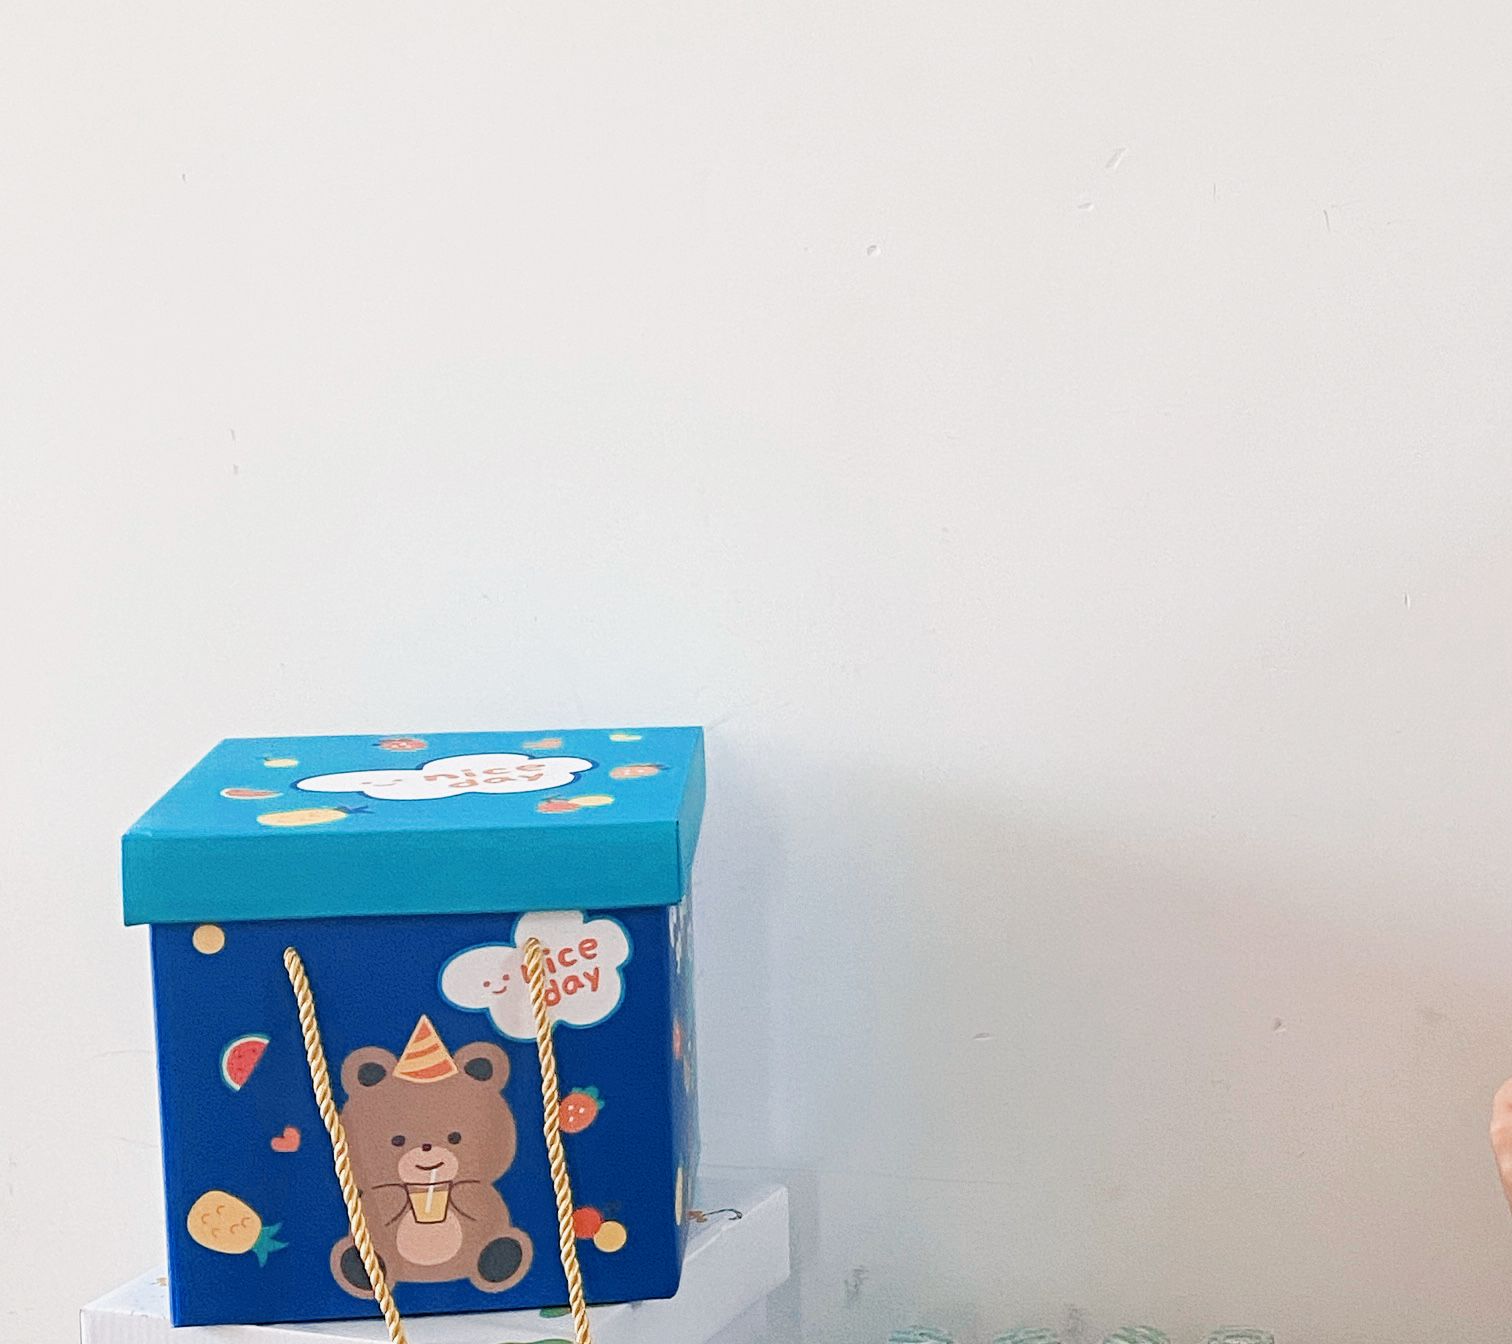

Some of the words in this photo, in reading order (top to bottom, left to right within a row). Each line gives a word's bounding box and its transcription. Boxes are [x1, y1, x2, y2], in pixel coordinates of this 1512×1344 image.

[424, 762, 547, 785] nice
[450, 772, 544, 790] day
[544, 967, 601, 1007] day
